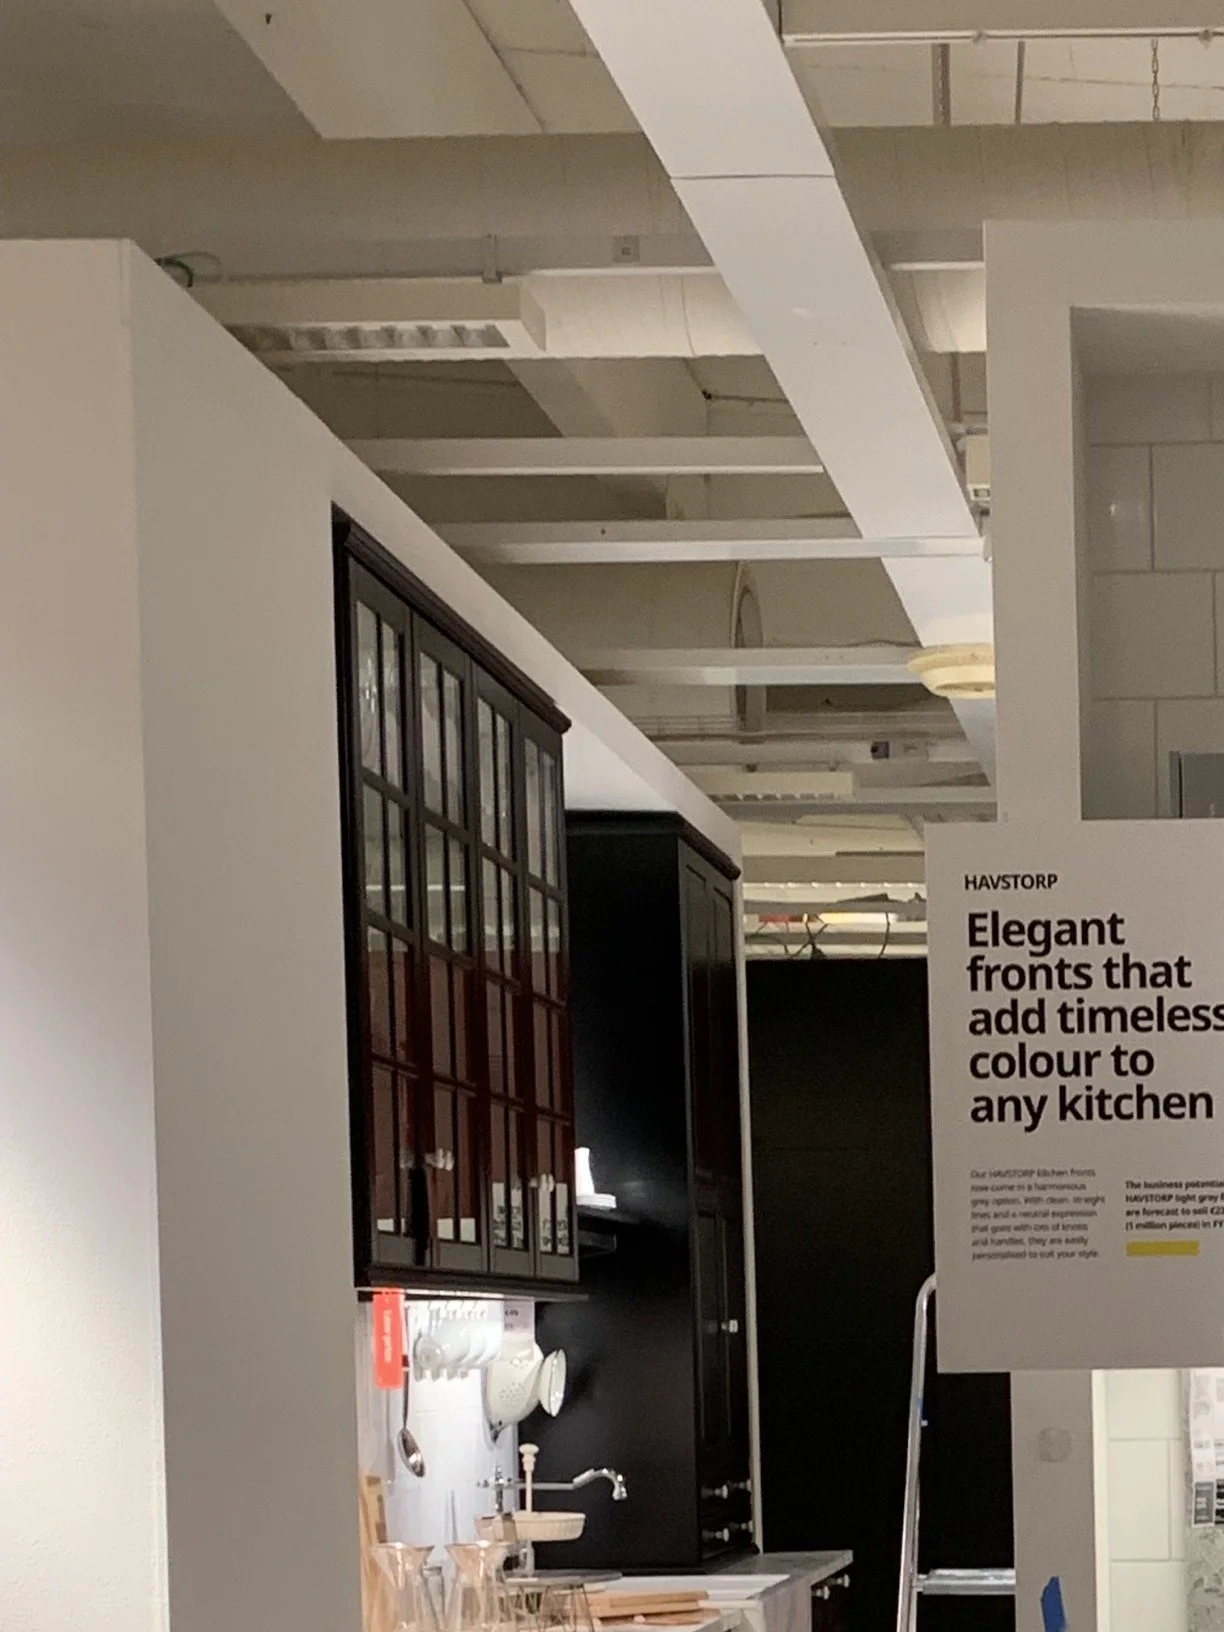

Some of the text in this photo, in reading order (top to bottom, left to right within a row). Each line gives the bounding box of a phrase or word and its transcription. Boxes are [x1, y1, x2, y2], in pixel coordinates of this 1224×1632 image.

[964, 873, 1058, 891] HAVSTORP
[968, 910, 1126, 958] Elegant
[965, 952, 1193, 993] fronts that
[968, 997, 1046, 1037] add
[969, 1041, 1155, 1080] colour to
[970, 1083, 1214, 1134] any kitchen
[1126, 1181, 1141, 1189] The
[1144, 1181, 1183, 1189] business
[1126, 1194, 1173, 1202] HAVSTORP
[1175, 1194, 1196, 1203] light
[1199, 1194, 1218, 1203] grey
[1143, 1208, 1179, 1216] forecast
[1193, 1207, 1207, 1215] sell
